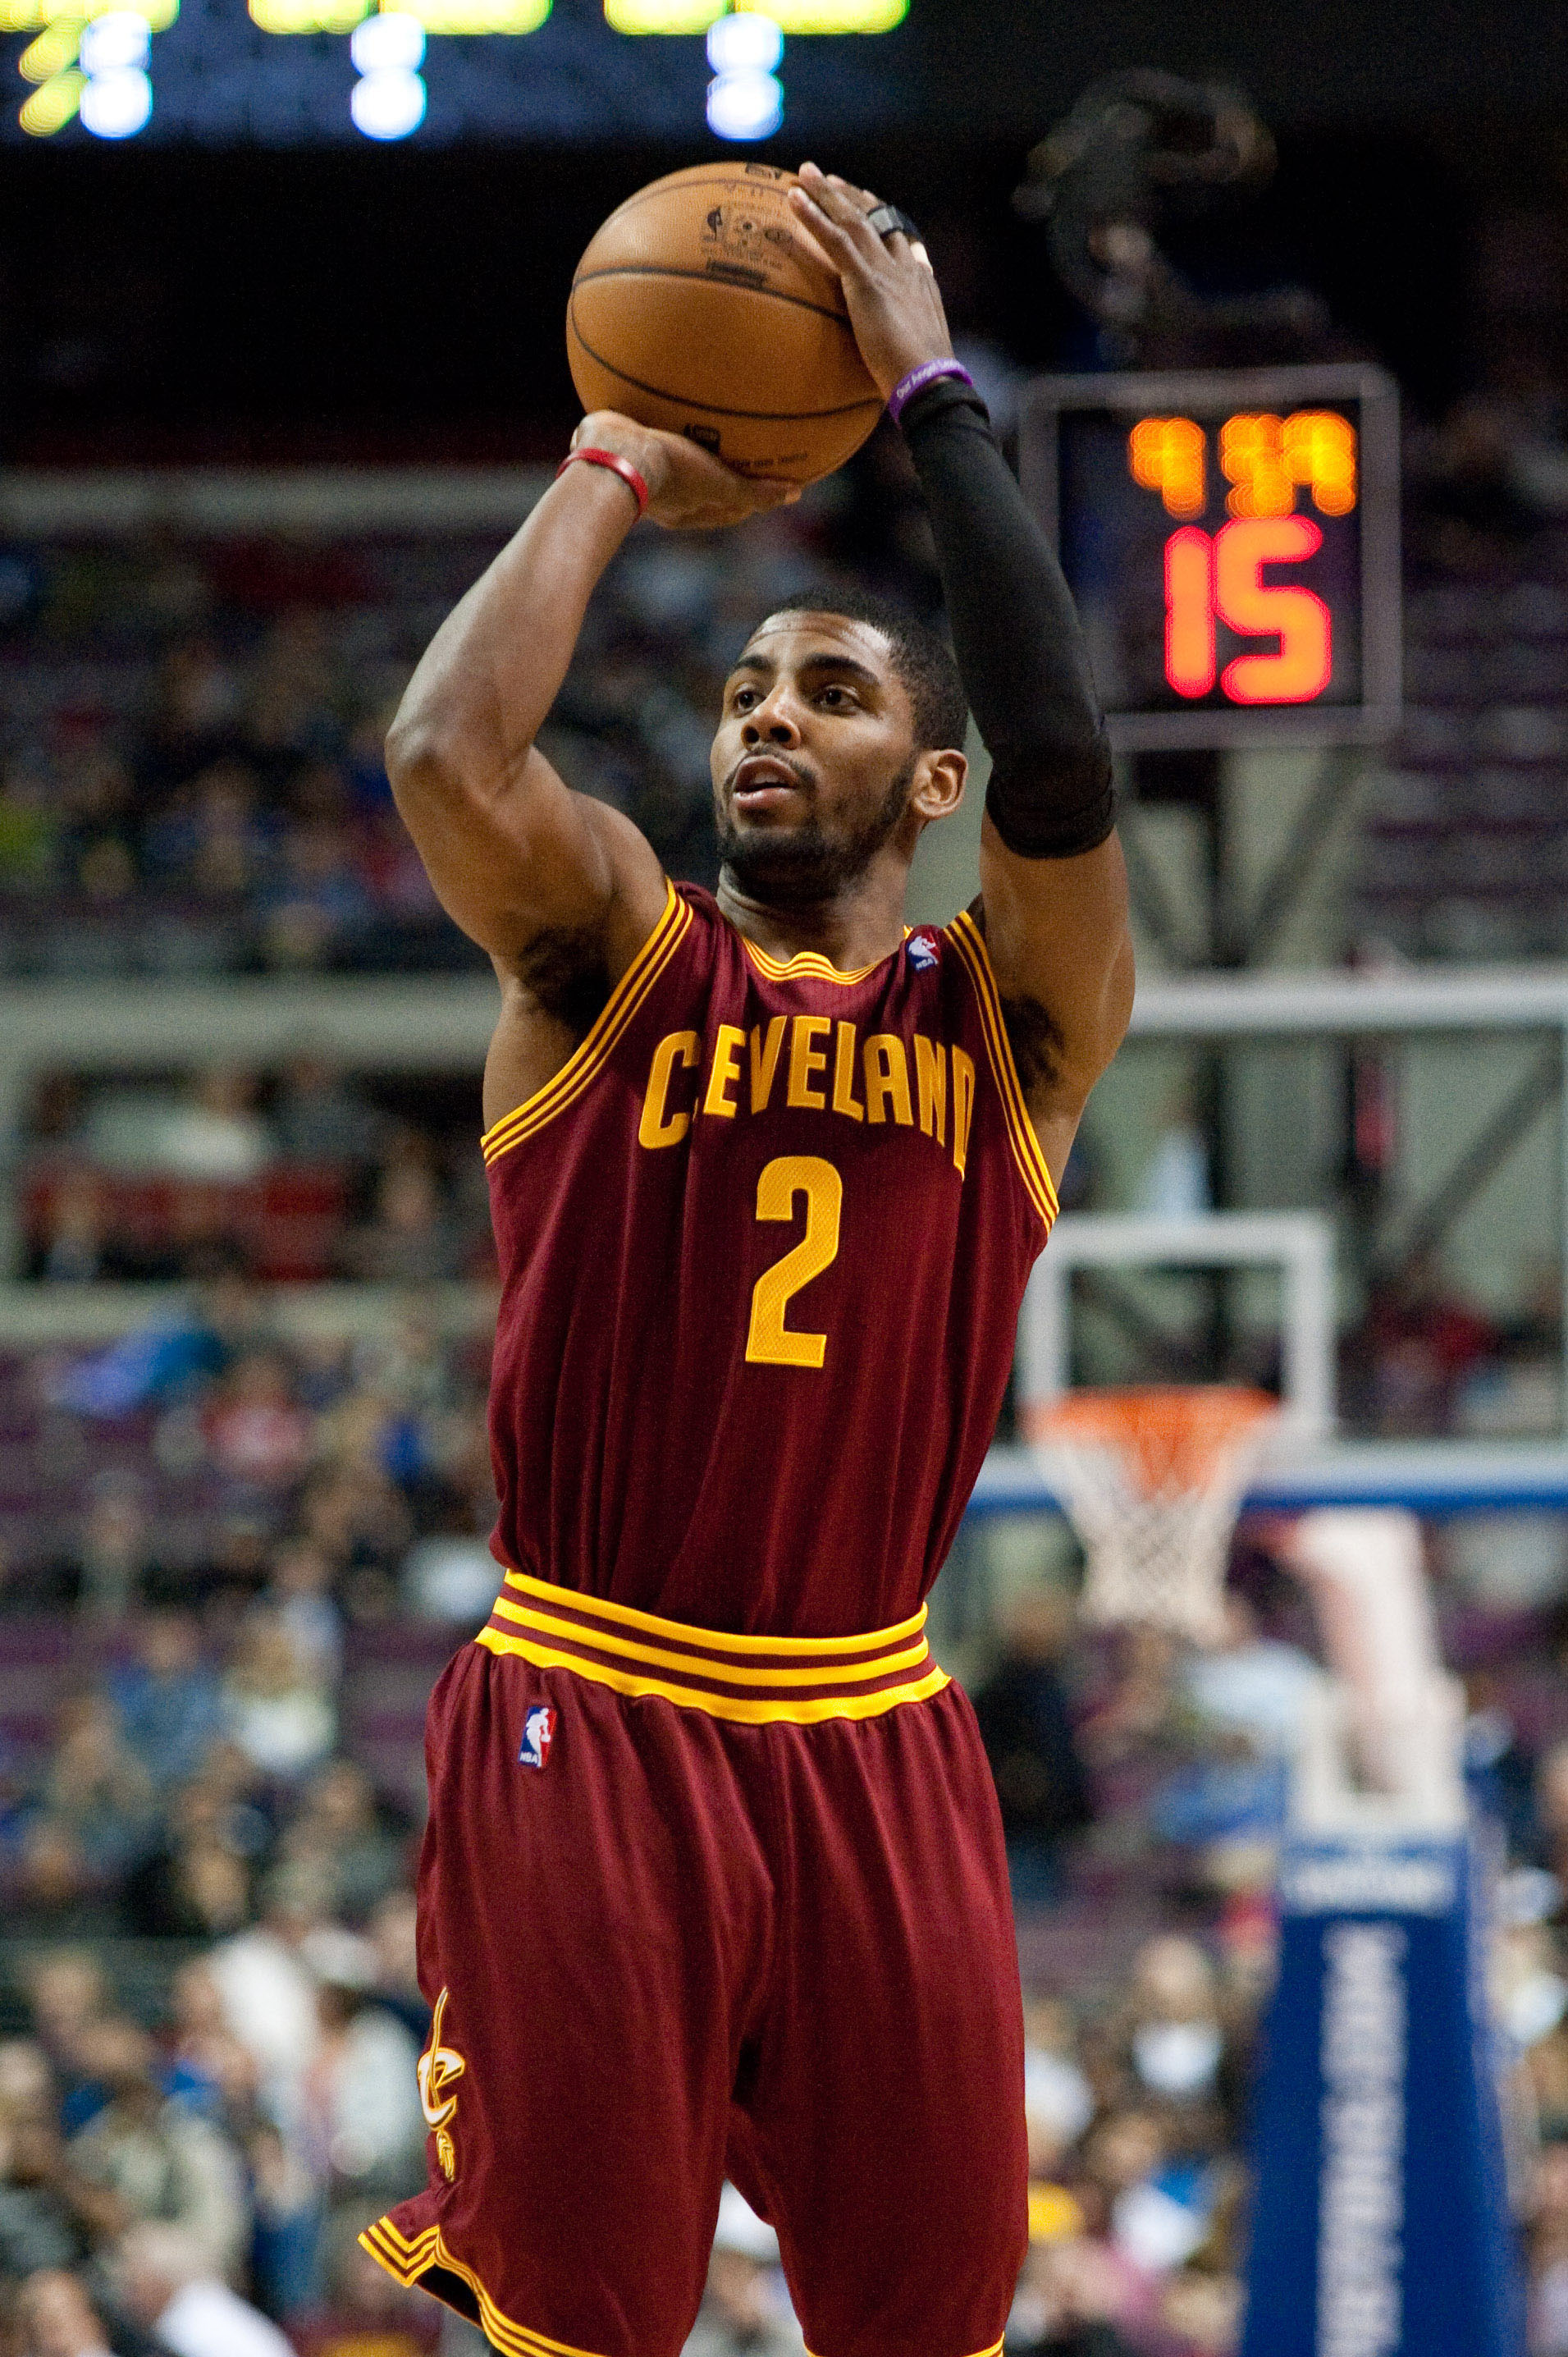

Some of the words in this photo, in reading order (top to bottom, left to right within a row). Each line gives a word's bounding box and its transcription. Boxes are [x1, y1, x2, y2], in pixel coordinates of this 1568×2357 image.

[1164, 515, 1333, 704] 15
[638, 1015, 976, 1181] CEVELAND
[745, 1156, 843, 1368] 2
[519, 1751, 538, 1764] NBA
